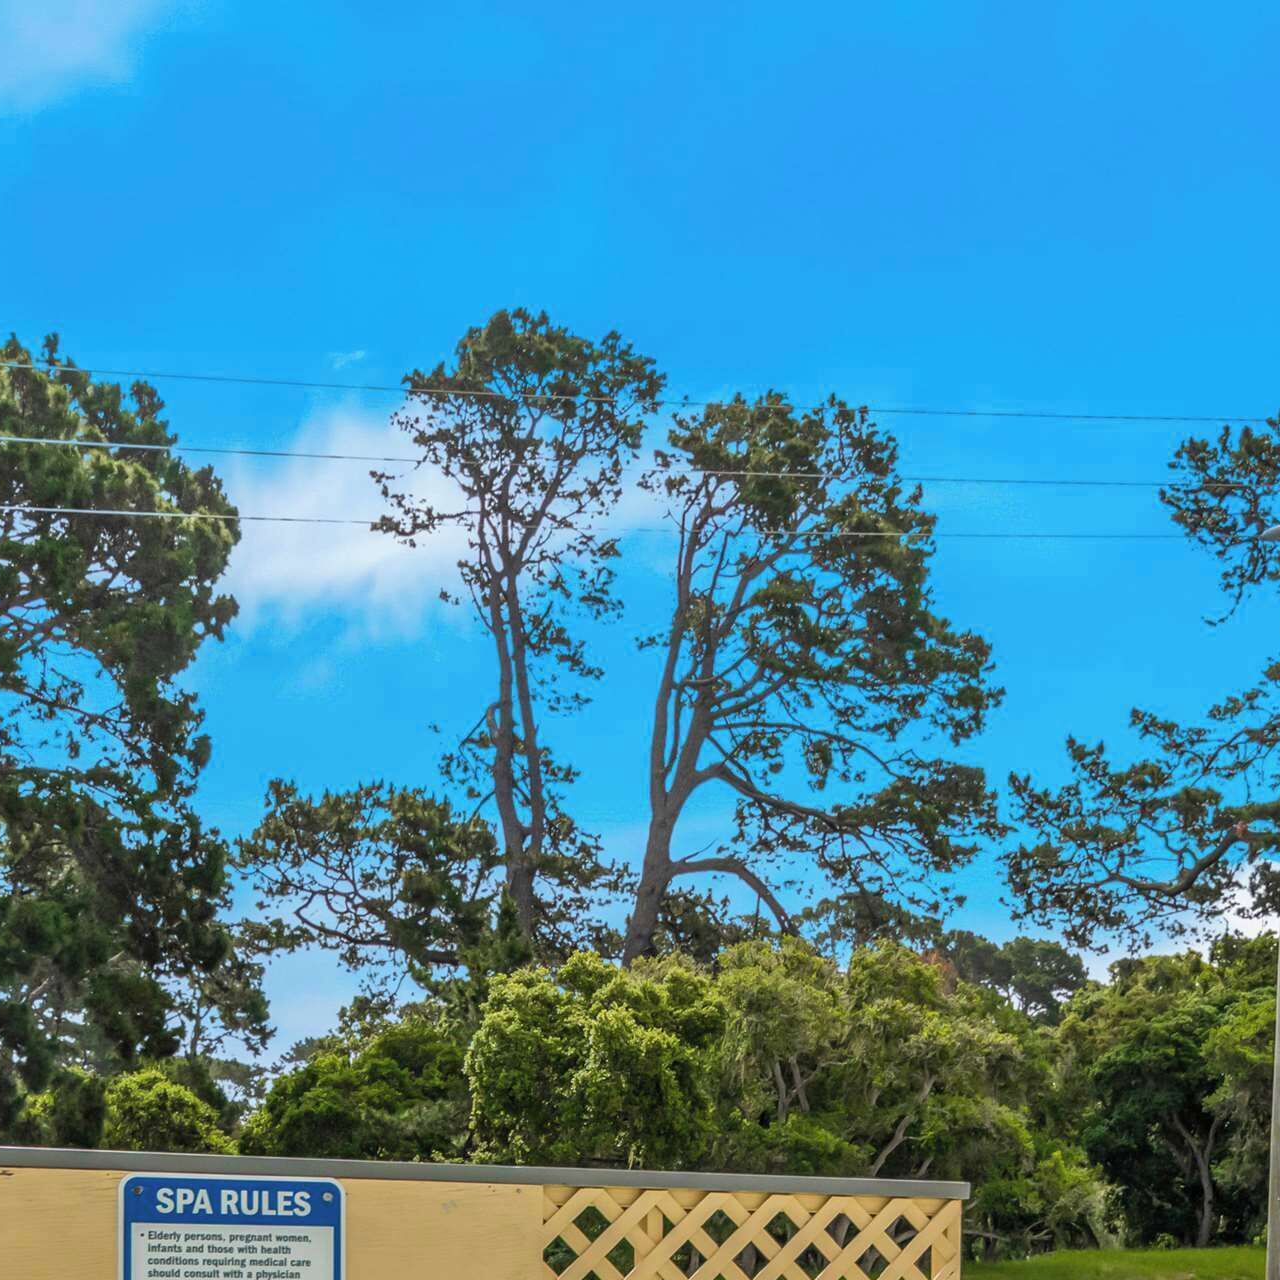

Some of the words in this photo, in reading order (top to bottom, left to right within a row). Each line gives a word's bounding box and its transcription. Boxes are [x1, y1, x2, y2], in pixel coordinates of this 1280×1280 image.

[156, 1187, 213, 1214] SPA
[220, 1190, 312, 1216] RULES
[148, 1231, 181, 1242] Elderly
[229, 1232, 272, 1243] pregnant
[148, 1243, 184, 1253] infants
[185, 1244, 204, 1254] and
[207, 1244, 234, 1254] those
[236, 1244, 258, 1254] with
[261, 1244, 291, 1254] health
[148, 1256, 199, 1266] conditions
[202, 1257, 246, 1268] requiring
[249, 1257, 287, 1267] medical
[290, 1259, 311, 1267] care
[147, 1269, 181, 1279] should
[184, 1269, 220, 1279] consult
[223, 1269, 243, 1279] with
[246, 1271, 253, 1279] a
[256, 1269, 300, 1280] physician
